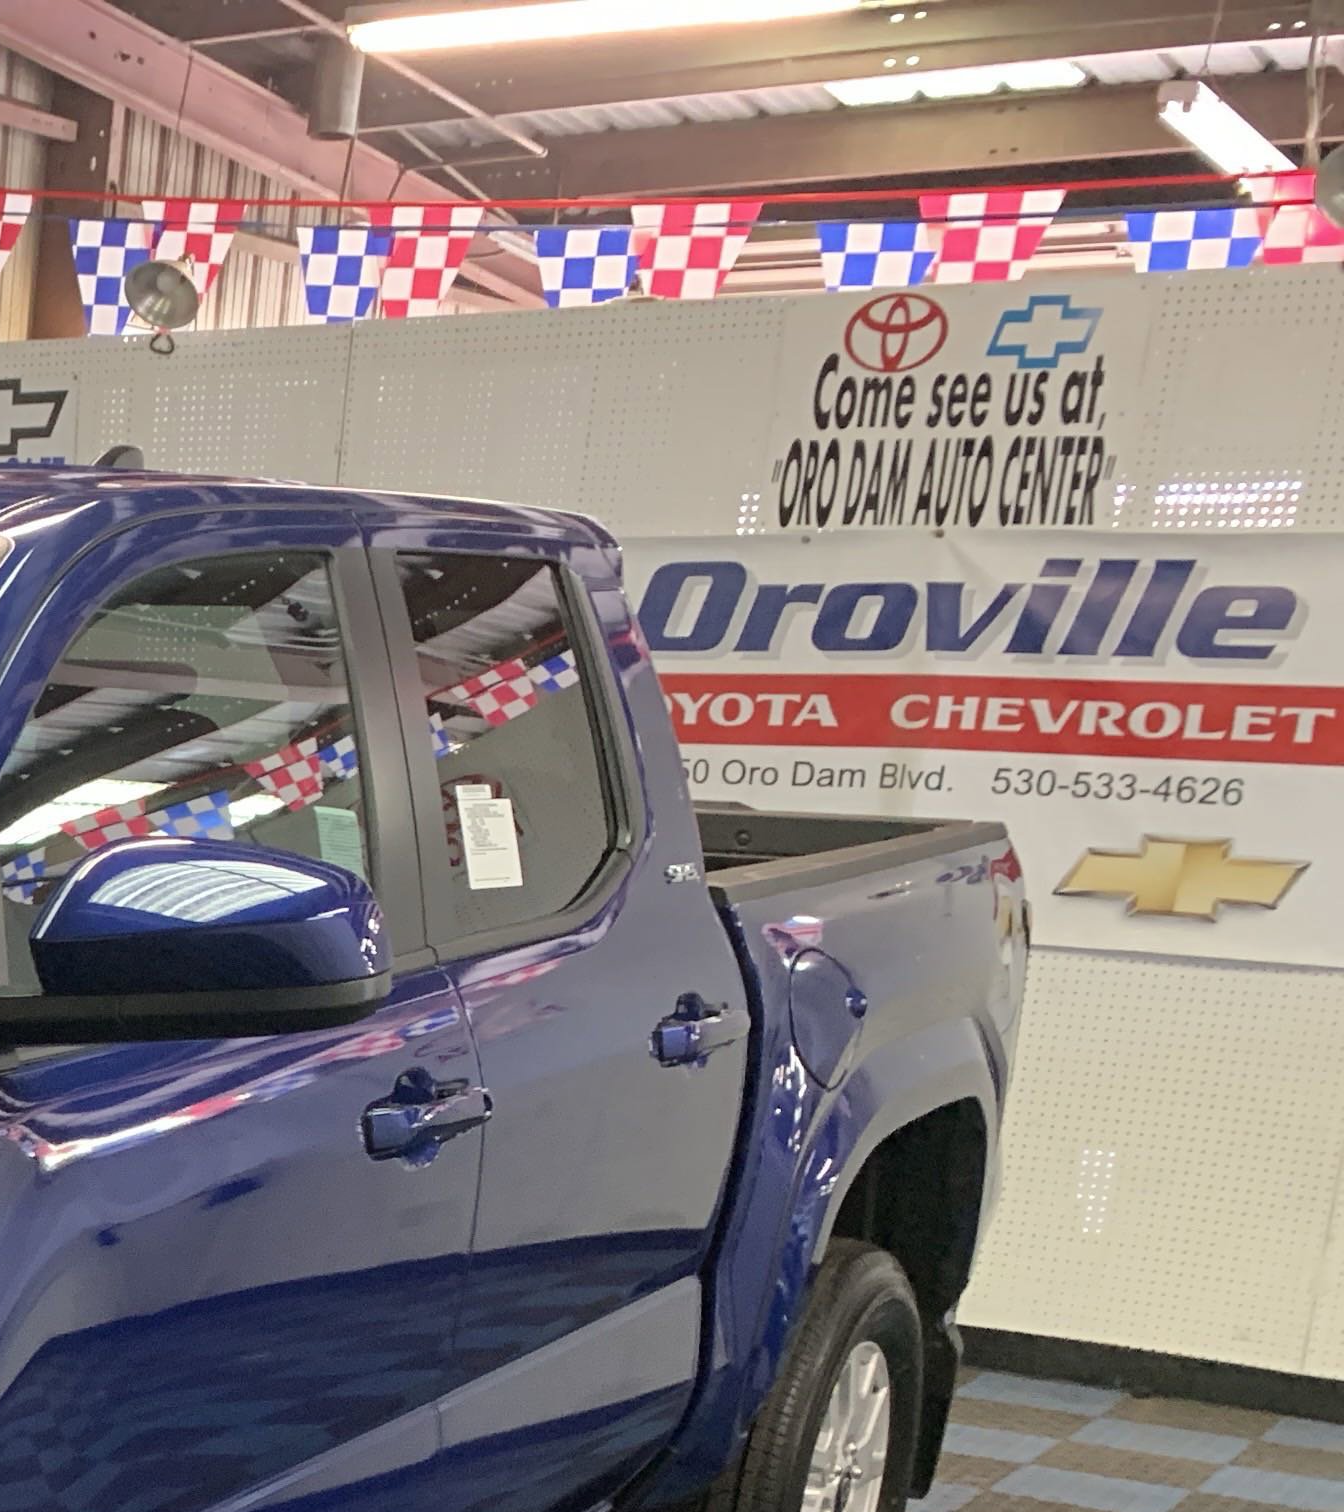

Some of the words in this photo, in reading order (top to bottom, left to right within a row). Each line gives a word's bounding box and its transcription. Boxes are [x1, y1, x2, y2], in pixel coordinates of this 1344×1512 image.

[814, 353, 915, 430] Come
[926, 372, 992, 428] see
[1004, 370, 1048, 426] us
[1061, 354, 1106, 431] at,
[771, 438, 840, 527] "ORO
[842, 438, 913, 526] DAM
[912, 434, 993, 527] AUTO
[999, 434, 1117, 527] CENTER"
[637, 558, 1298, 660] Oroville
[664, 691, 838, 728] YOTA
[890, 693, 1336, 744] CHEVROLET
[722, 759, 779, 787] Oro
[791, 761, 866, 788] Dam
[879, 763, 954, 792] Blvd.
[991, 767, 1246, 807] 530-533-4626
